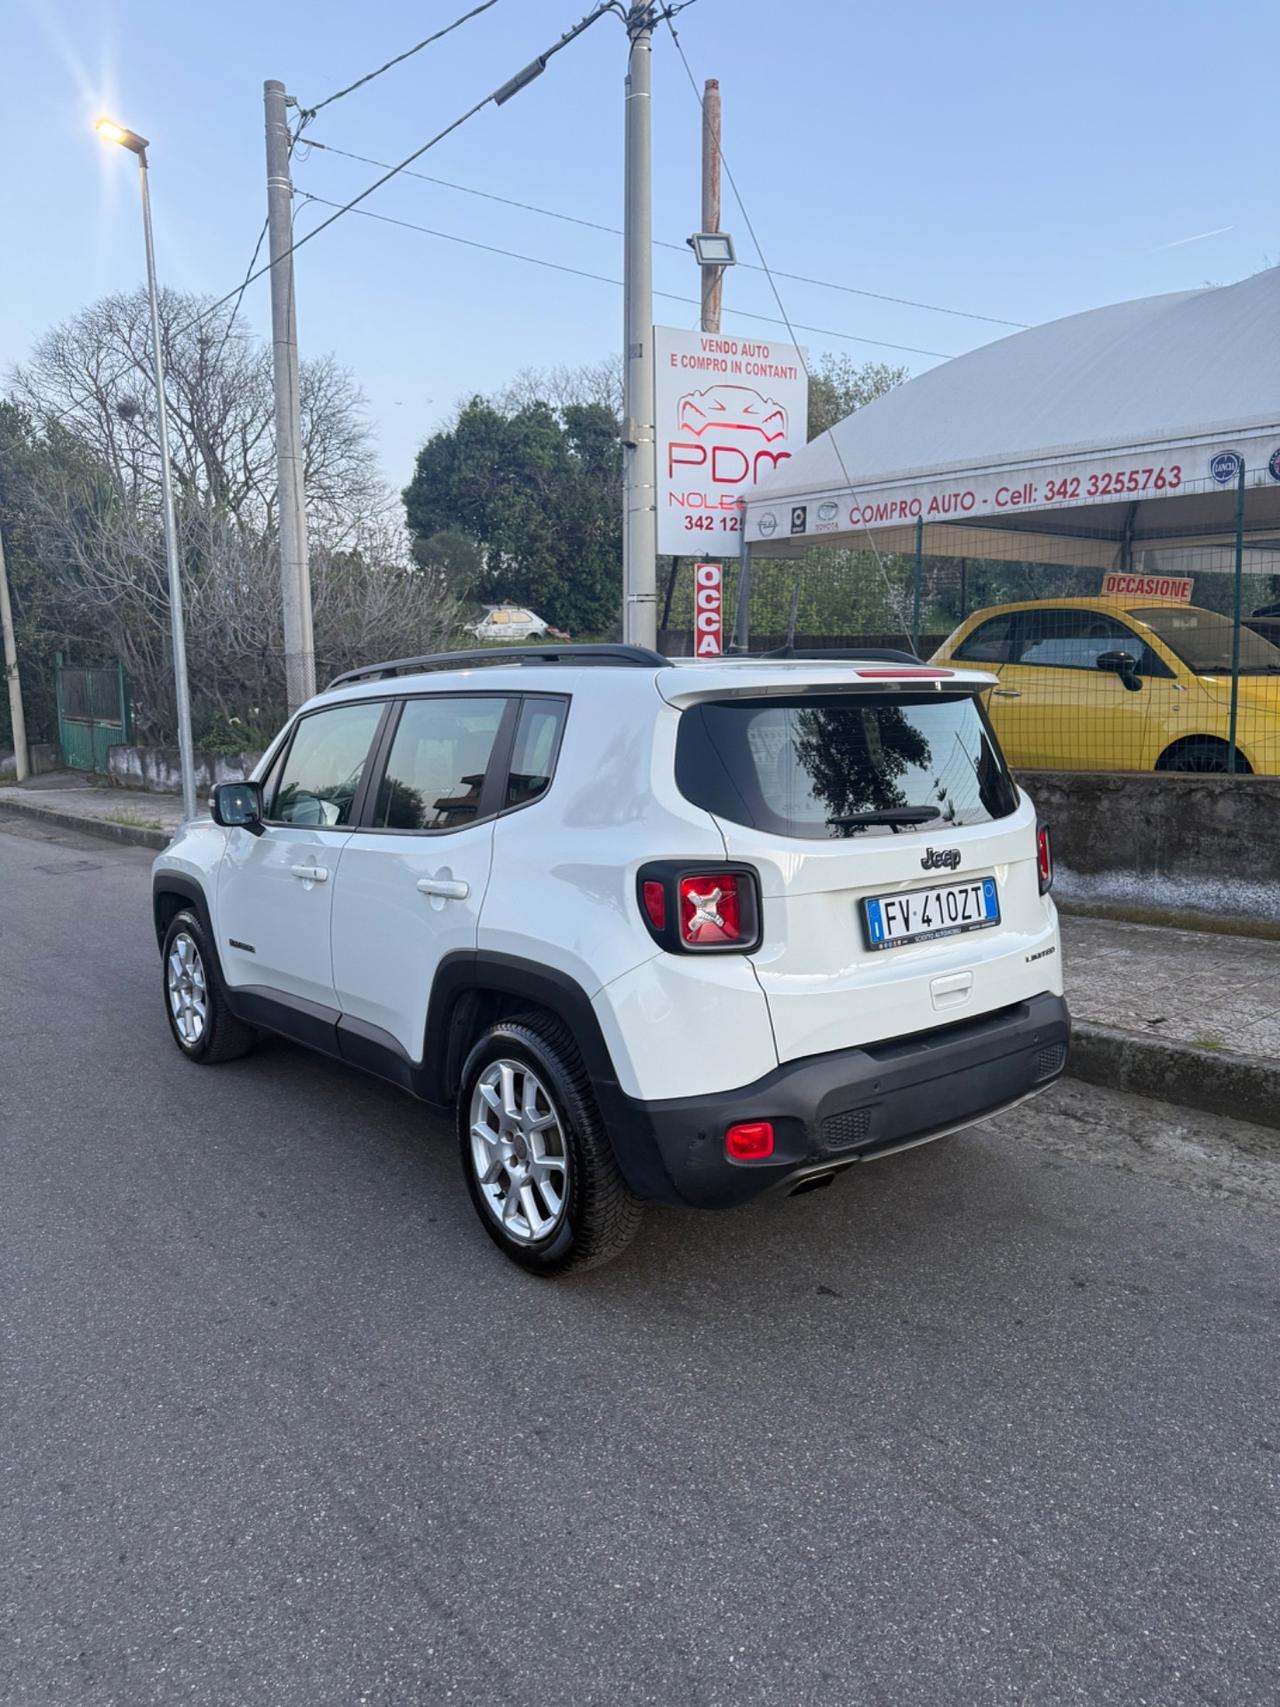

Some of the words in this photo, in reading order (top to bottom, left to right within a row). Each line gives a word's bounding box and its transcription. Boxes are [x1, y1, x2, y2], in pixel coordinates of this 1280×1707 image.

[701, 338, 738, 355] VENDO
[741, 343, 770, 359] AUTO
[670, 353, 678, 367] E
[681, 355, 728, 372] COMPRO
[731, 360, 742, 374] IN
[745, 362, 797, 380] CONTANTI
[849, 498, 922, 525] COMPRO
[928, 491, 976, 515] AUTO
[995, 482, 1038, 507] Cell:
[1044, 476, 1081, 501] 342
[1087, 465, 1182, 496] 3255763
[684, 515, 714, 531] 342
[1107, 576, 1190, 597] OCCASIONE
[921, 847, 961, 870] Jeep
[884, 900, 910, 936] FV
